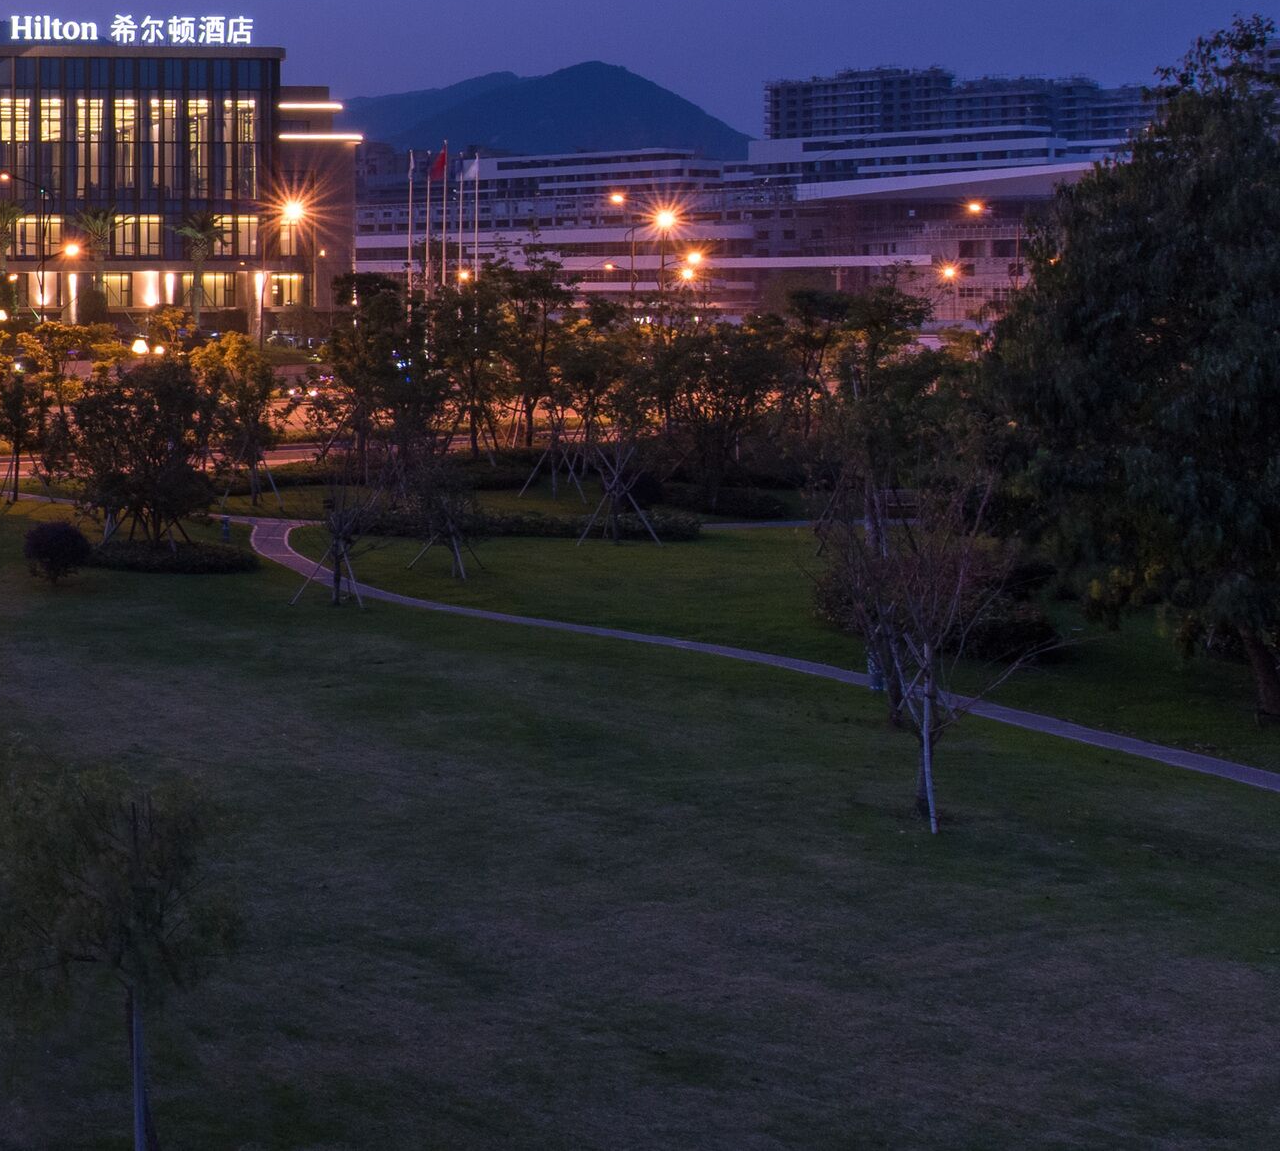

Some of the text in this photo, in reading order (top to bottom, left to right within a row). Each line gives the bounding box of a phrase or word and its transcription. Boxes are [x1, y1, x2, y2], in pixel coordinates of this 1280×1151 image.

[10, 13, 254, 45] Hilton 希尔顿酒店
